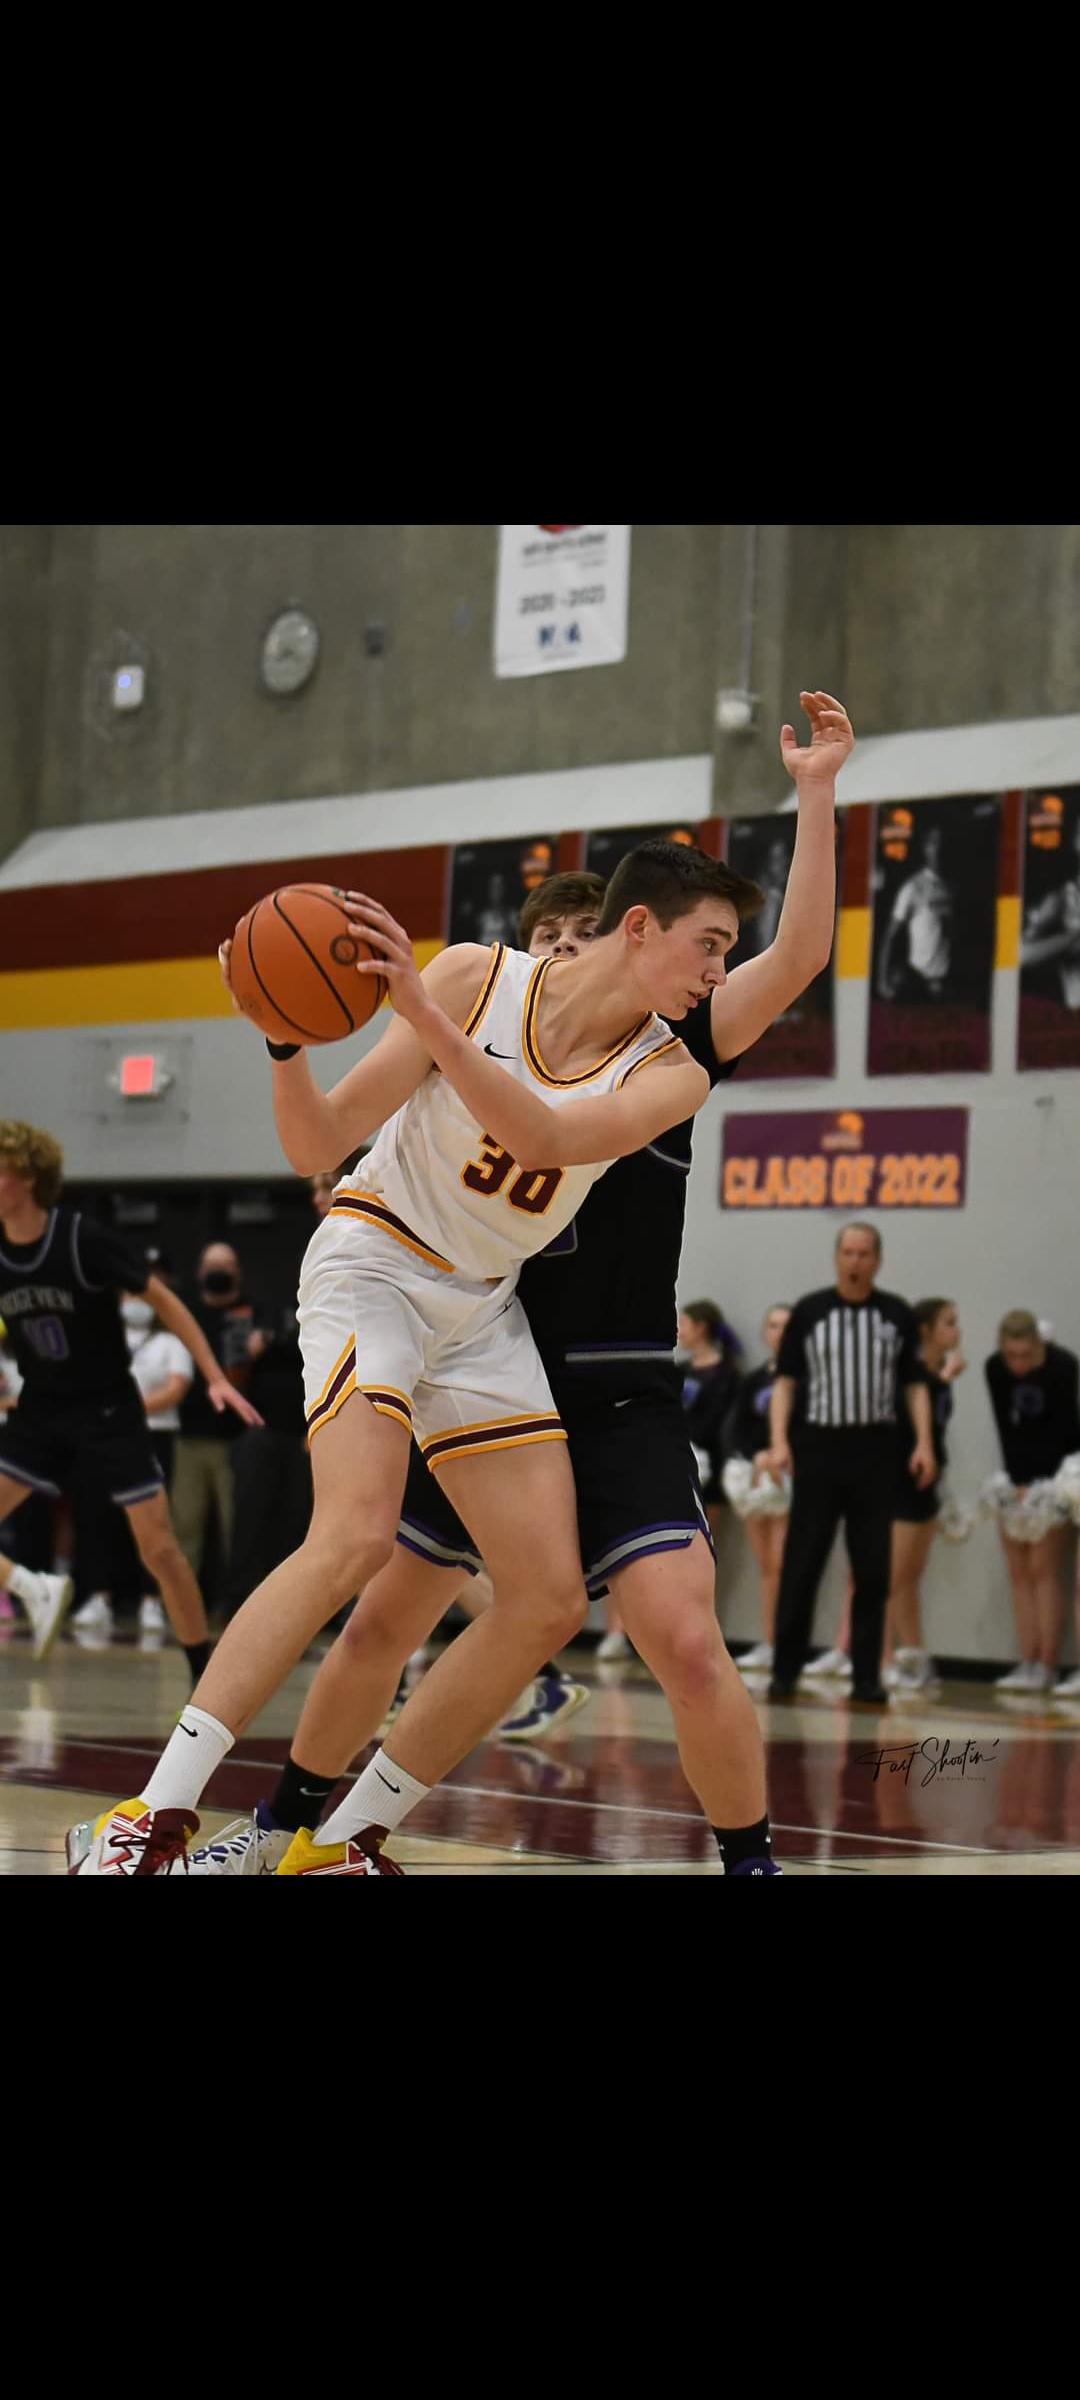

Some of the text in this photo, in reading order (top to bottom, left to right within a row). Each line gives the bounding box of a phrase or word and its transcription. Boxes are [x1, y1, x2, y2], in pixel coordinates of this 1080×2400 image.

[460, 1131, 566, 1217] 30
[724, 1153, 960, 1206] CLASS OF 2022
